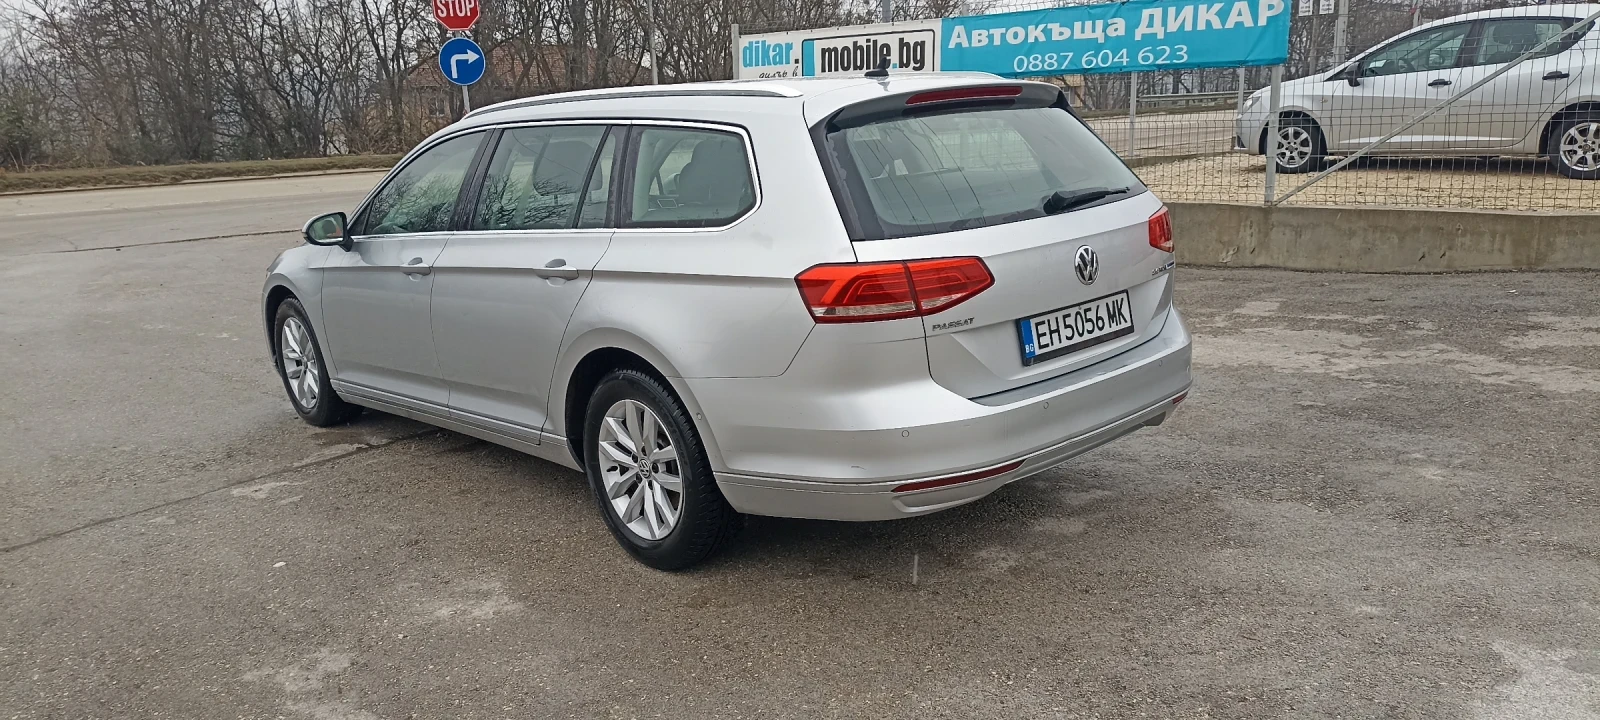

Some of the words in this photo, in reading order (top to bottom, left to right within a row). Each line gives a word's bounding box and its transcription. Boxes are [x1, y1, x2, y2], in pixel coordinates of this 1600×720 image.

[437, 0, 475, 17] STOP
[948, 17, 1126, 49] Автокъща
[1134, 0, 1284, 41] ДИКАР
[820, 37, 926, 73] mobile.bg
[1013, 52, 1074, 73] 0887
[1081, 48, 1130, 70] 604
[1137, 44, 1188, 65] 623
[932, 316, 975, 332] PASSAT
[1024, 344, 1035, 354] BG
